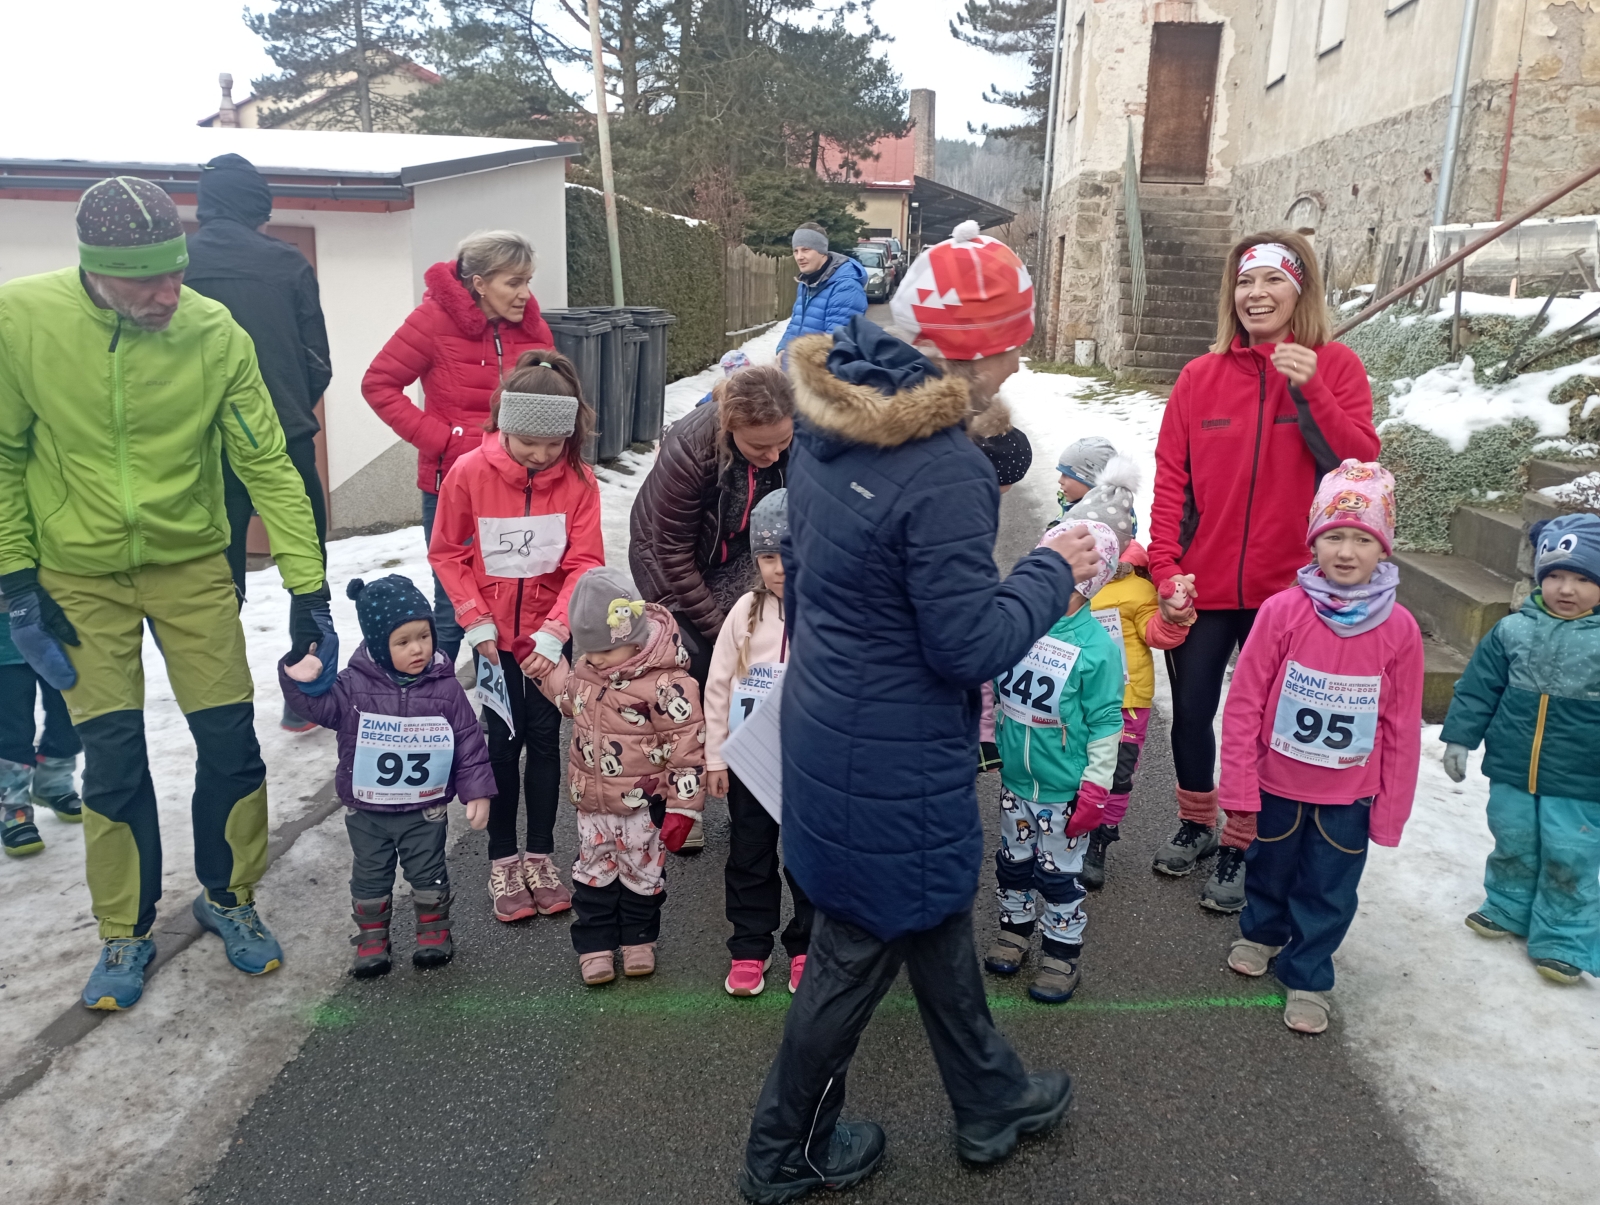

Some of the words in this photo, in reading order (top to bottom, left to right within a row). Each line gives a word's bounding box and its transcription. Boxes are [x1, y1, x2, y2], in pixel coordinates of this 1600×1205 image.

[498, 529, 535, 557] 58
[1034, 643, 1073, 661] 024-2025
[1042, 655, 1068, 671] LIGA
[748, 666, 773, 679] IMNÍ
[1288, 667, 1328, 690] ZIMNÍ
[741, 677, 773, 690] BĚŽEC
[999, 668, 1055, 714] 242
[1285, 679, 1345, 704] BĚŽECKÁ
[1348, 696, 1376, 705] LIGA
[1328, 685, 1378, 693] 2024-2025
[362, 719, 402, 733] ZIMNÍ
[1293, 707, 1355, 750] 95
[361, 731, 420, 744] BĚŽECKÁ
[423, 734, 450, 743] LIGA
[376, 752, 431, 787] 93
